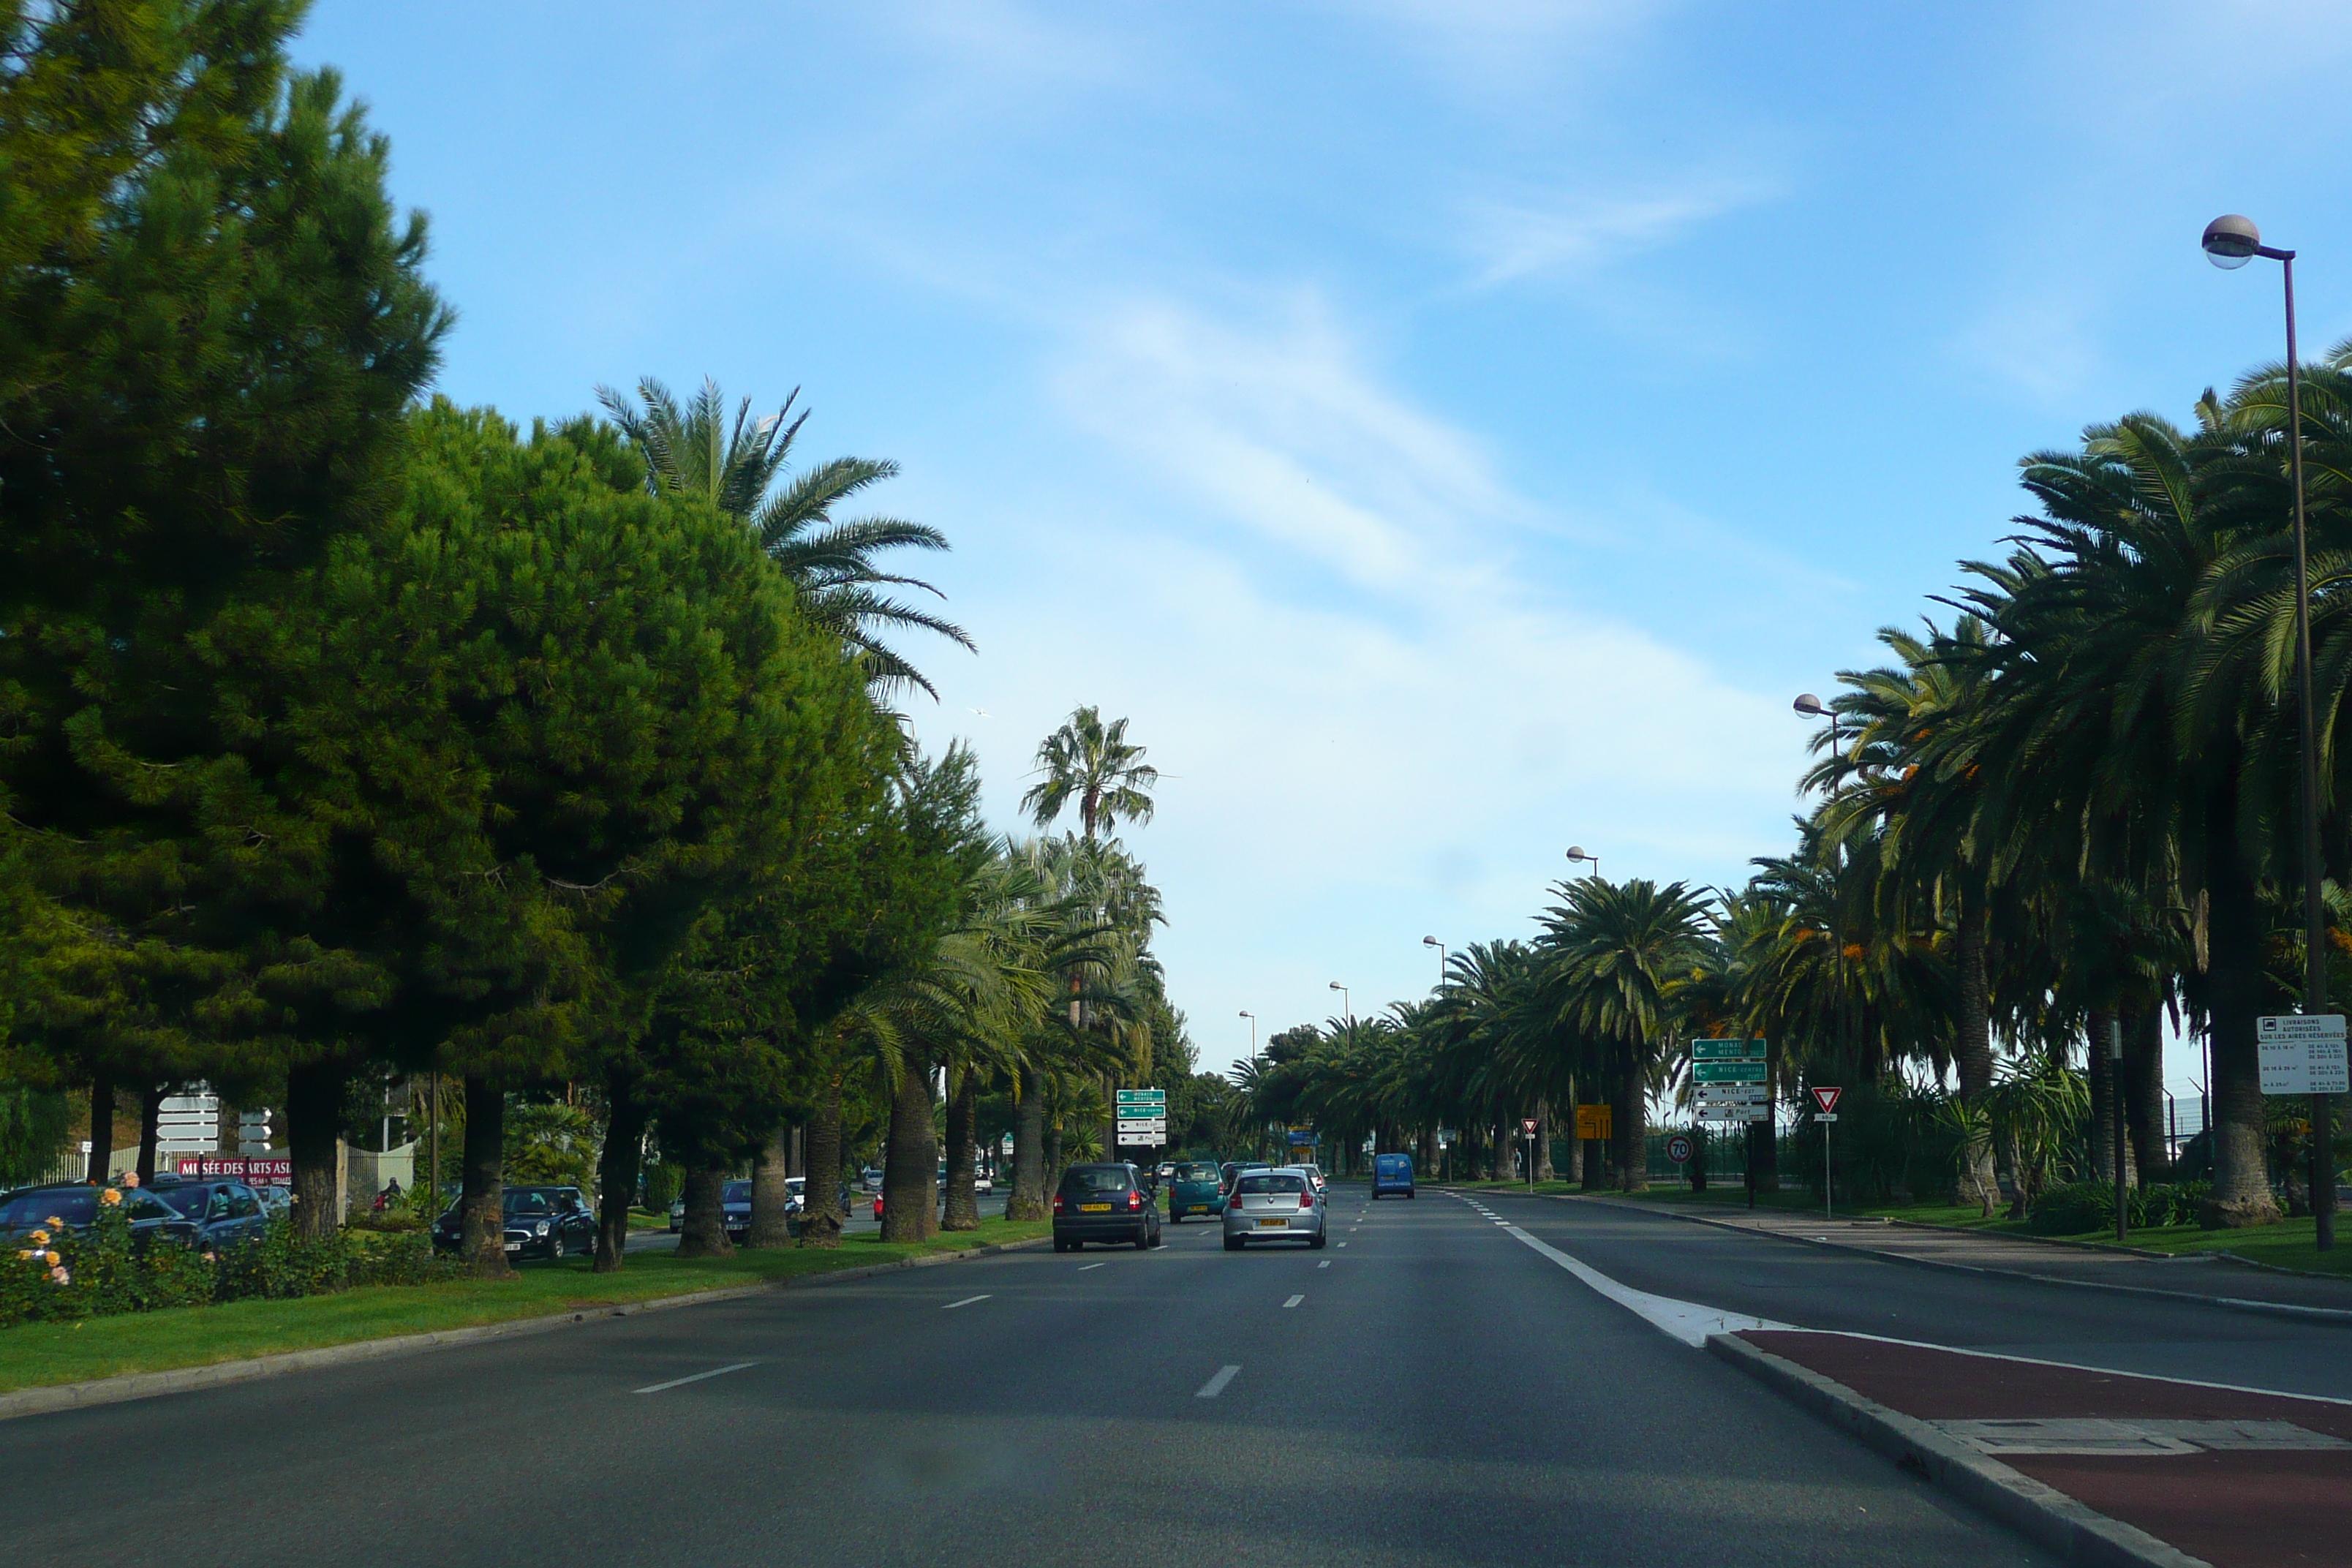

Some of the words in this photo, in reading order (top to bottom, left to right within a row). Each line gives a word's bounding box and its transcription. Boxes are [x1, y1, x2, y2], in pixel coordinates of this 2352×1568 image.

[1673, 1143, 1687, 1156] 70
[224, 1162, 244, 1175] DES
[274, 1162, 292, 1175] ASI
